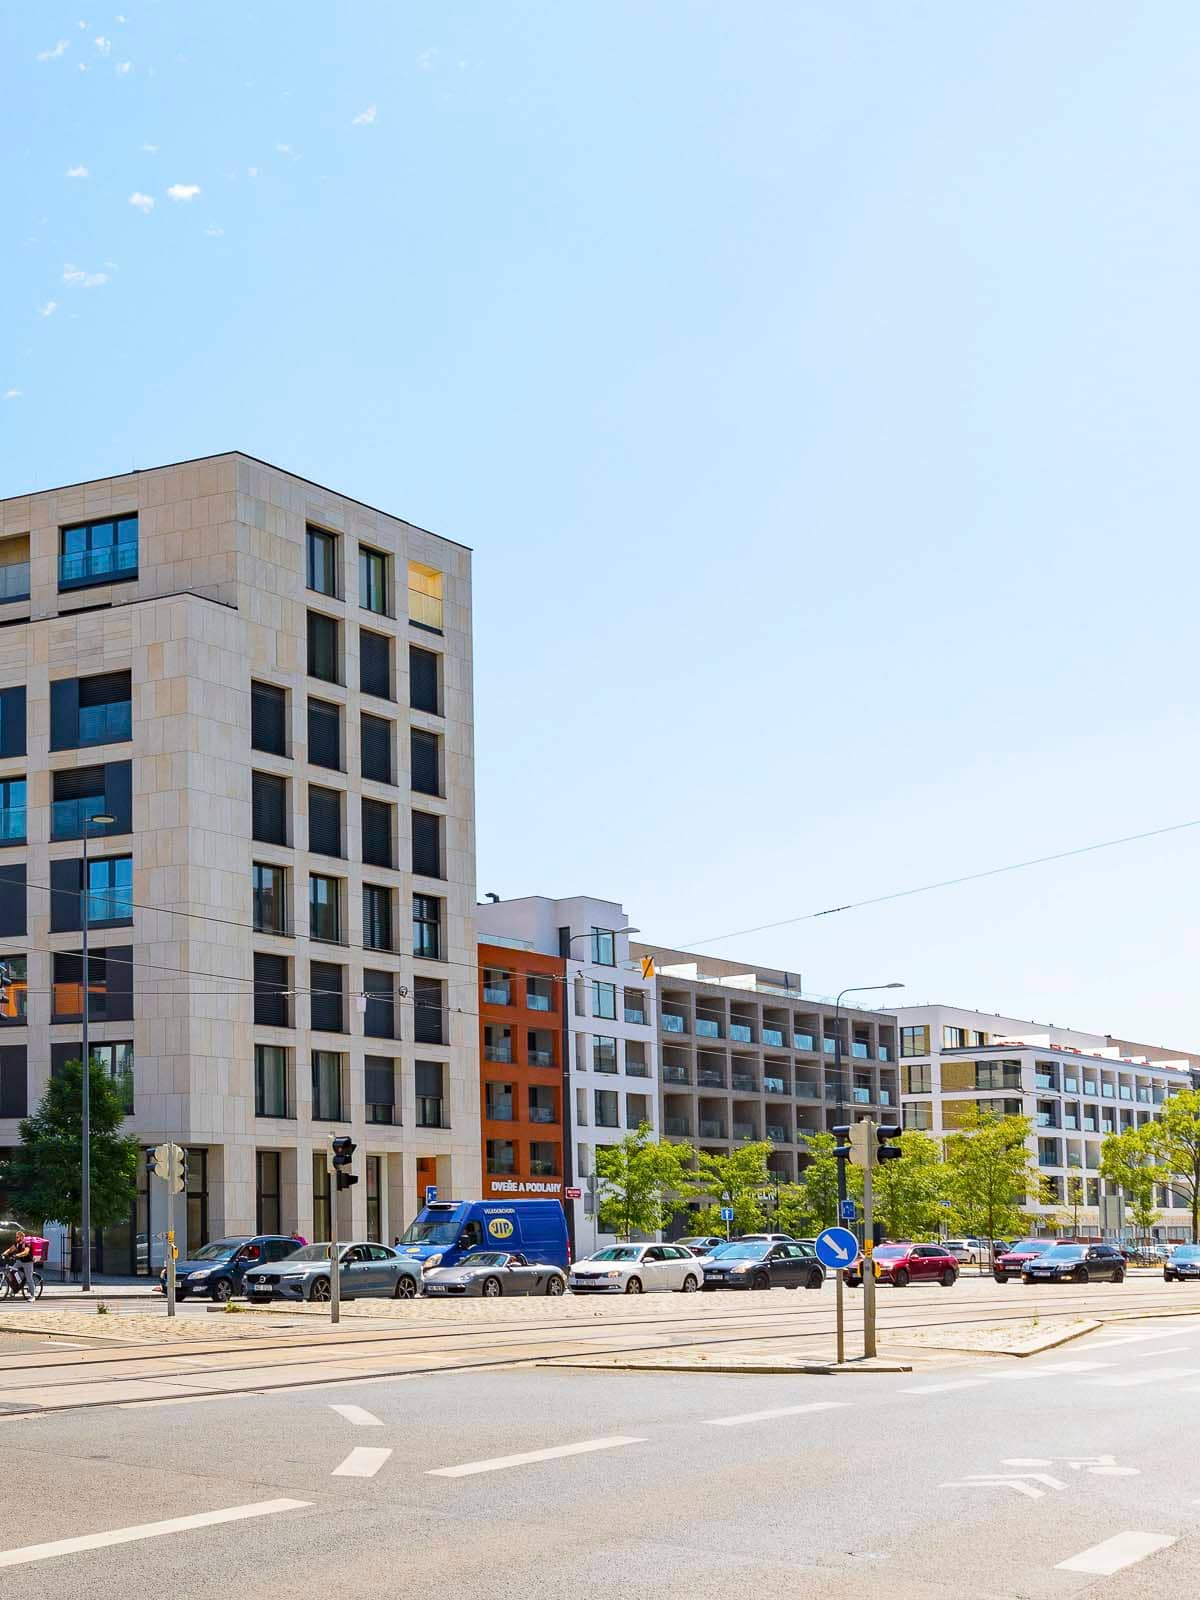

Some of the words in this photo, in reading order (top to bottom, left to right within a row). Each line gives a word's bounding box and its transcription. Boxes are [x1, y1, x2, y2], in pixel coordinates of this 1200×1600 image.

[491, 1180, 517, 1192] DVEŘE
[519, 1182, 525, 1192] A
[526, 1183, 561, 1192] PODLAHY
[494, 1222, 509, 1234] JIP
